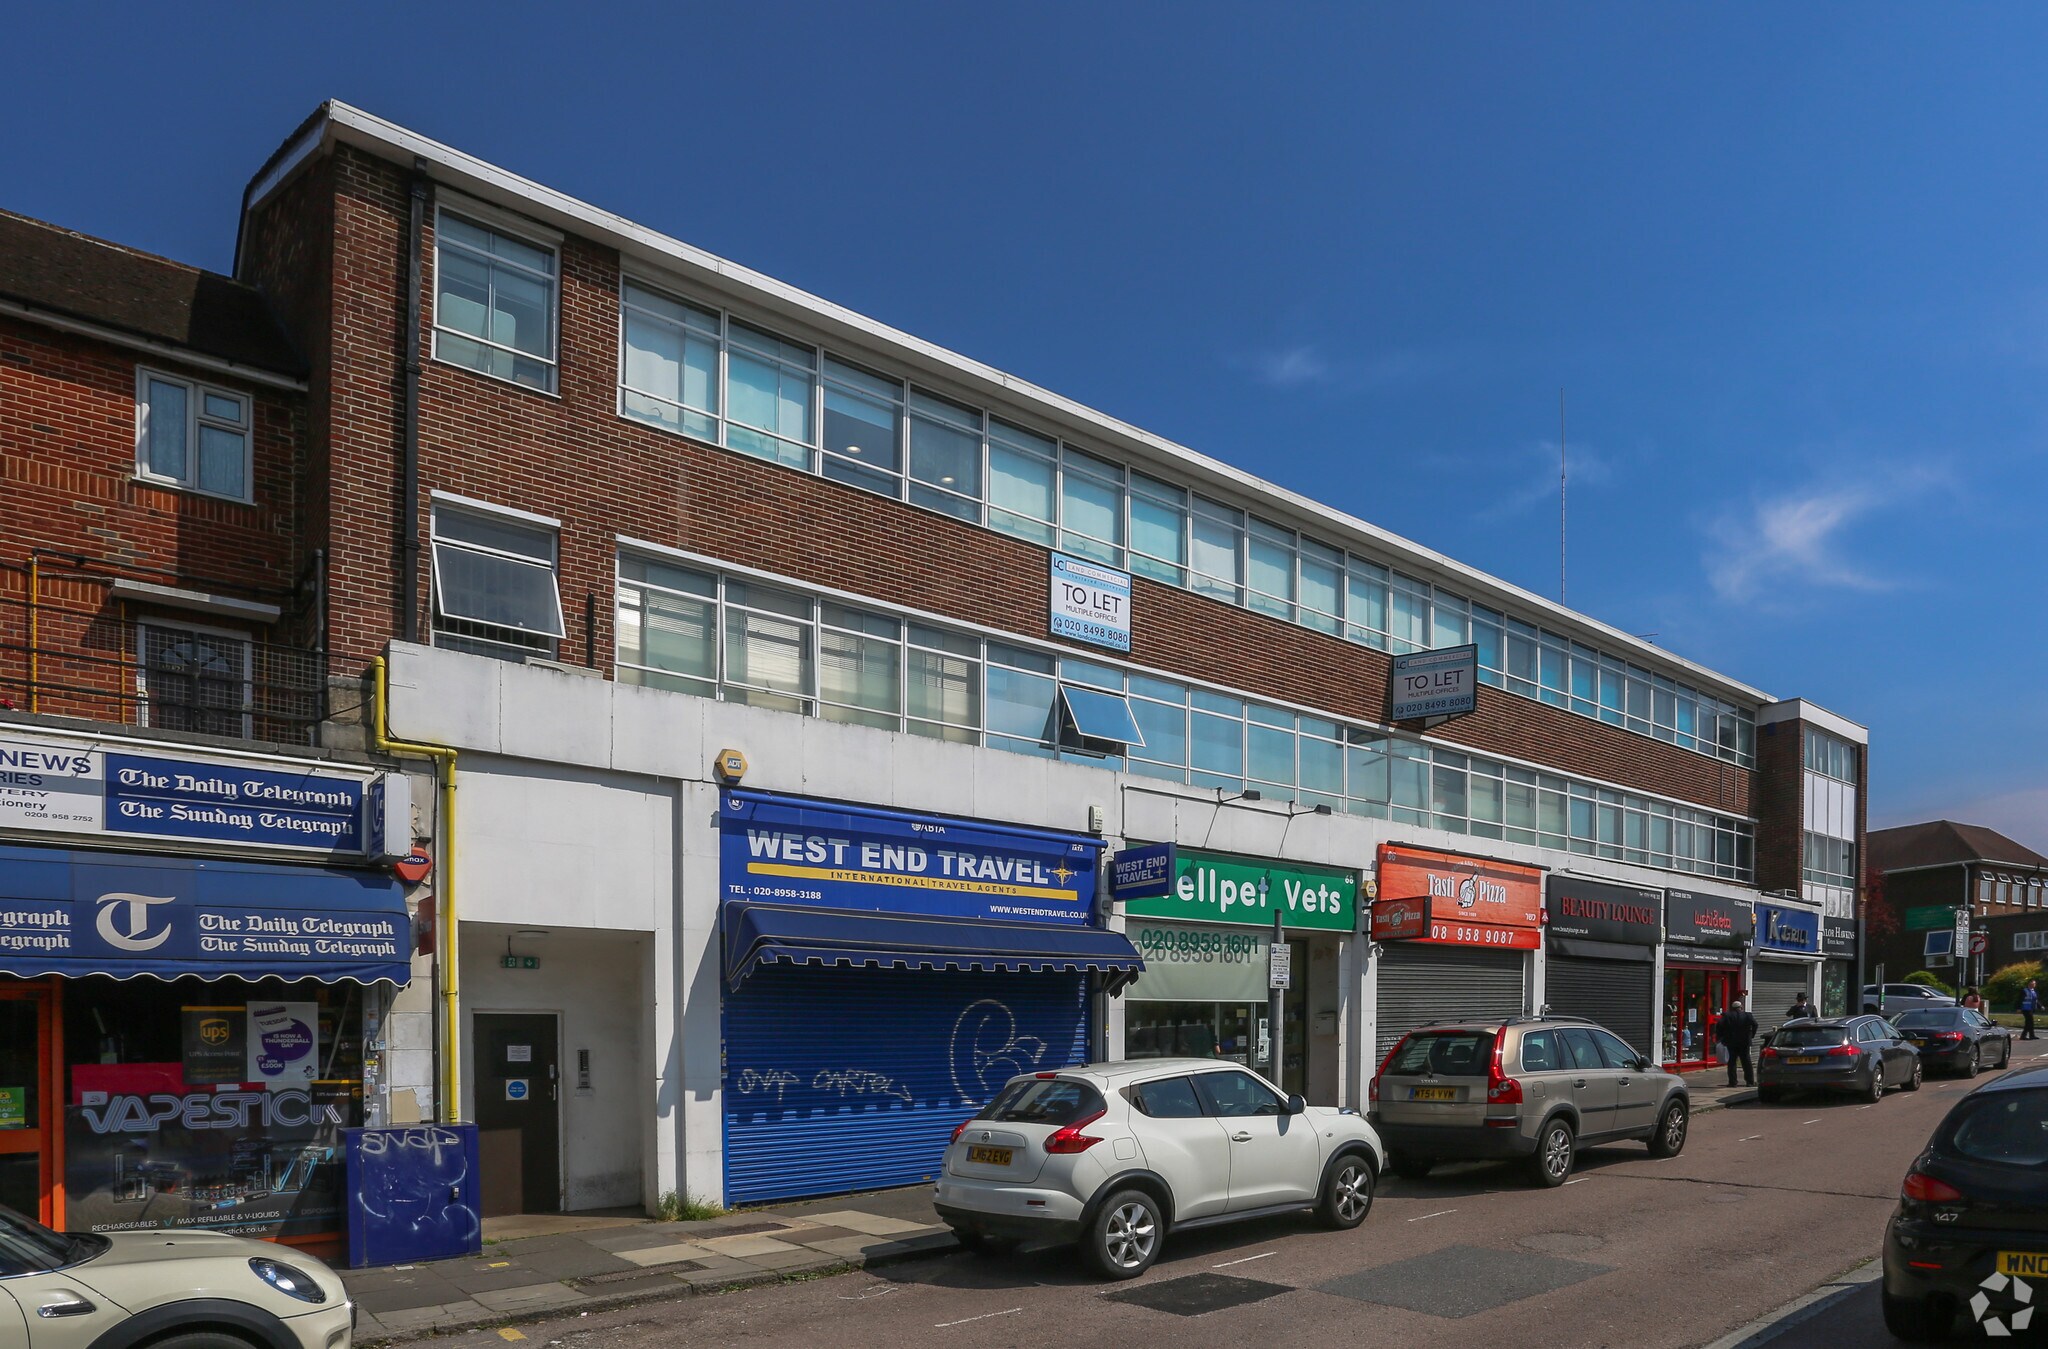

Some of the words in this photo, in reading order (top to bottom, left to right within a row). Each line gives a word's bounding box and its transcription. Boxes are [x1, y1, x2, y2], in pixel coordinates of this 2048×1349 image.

[1068, 565, 1084, 574] LAND
[1087, 570, 1127, 586] COMMERCIAL
[1062, 583, 1087, 604] TO
[1093, 592, 1121, 613] LET
[1065, 605, 1092, 617] MULTIPLE
[1094, 612, 1117, 623] OFFICES
[1064, 619, 1080, 631] 020
[1084, 624, 1105, 637] 8498
[1107, 631, 1128, 643] 8080
[1404, 675, 1428, 690] TO
[1435, 670, 1464, 686] LET
[1408, 689, 1434, 698] MULTIPLE
[1436, 687, 1459, 695] OFFICES
[1406, 704, 1422, 712] 020
[1425, 700, 1446, 710] 8498
[1449, 697, 1471, 707] 8080
[0, 749, 91, 774] NEWS
[728, 758, 741, 769] ADT
[118, 768, 170, 789] The
[174, 774, 239, 800] Daily
[242, 780, 353, 809] Telegraph
[0, 798, 46, 811] ionery
[118, 801, 164, 819] The
[169, 803, 254, 830] Sunday
[258, 813, 354, 837] Telegraph
[747, 828, 850, 865] WEST
[862, 842, 927, 874] END
[937, 850, 1049, 885] TRAVEL
[1116, 860, 1143, 873] WEST
[1146, 856, 1167, 868] END
[831, 871, 925, 887] INTERNATIONAL
[932, 881, 972, 891] TRAVEL
[978, 884, 1017, 895] AGENTS
[1116, 869, 1153, 884] TRAVEL
[729, 884, 746, 894] TEL
[753, 886, 822, 900] 020-8958-3188
[1175, 868, 1269, 913] ellpet
[1284, 879, 1341, 914] Vets
[1427, 874, 1455, 897] Tasti
[1479, 881, 1506, 904] Pizza
[990, 905, 1089, 920] WWW.WESTENDTRAVEL.CO.UK
[1404, 911, 1420, 921] Pizza
[1562, 896, 1609, 919] BEAUTY
[1612, 903, 1655, 925] LOUNGE
[199, 914, 242, 931] The
[246, 915, 299, 936] Daily
[302, 917, 394, 937] Telegraph
[1781, 925, 1809, 945] GRILL
[1141, 928, 1175, 950] 020
[1178, 931, 1221, 953] 8958
[1224, 934, 1258, 954] 1601
[1458, 928, 1479, 942] 958
[1486, 929, 1514, 944] 9087
[201, 937, 238, 952] The
[243, 938, 311, 956] Sunday
[315, 939, 396, 957] Telegraph
[260, 1016, 288, 1026] TUESDAY
[203, 1026, 228, 1042] ups
[82, 1091, 342, 1134] VAPESTICK
[993, 1150, 1010, 1163] EVG
[91, 1220, 158, 1232] RECHARGEABLES
[177, 1216, 195, 1225] MAX
[197, 1214, 236, 1225] REFILLABLE
[244, 1210, 280, 1220] V-LIQUIDS
[1934, 1213, 1959, 1222] 147
